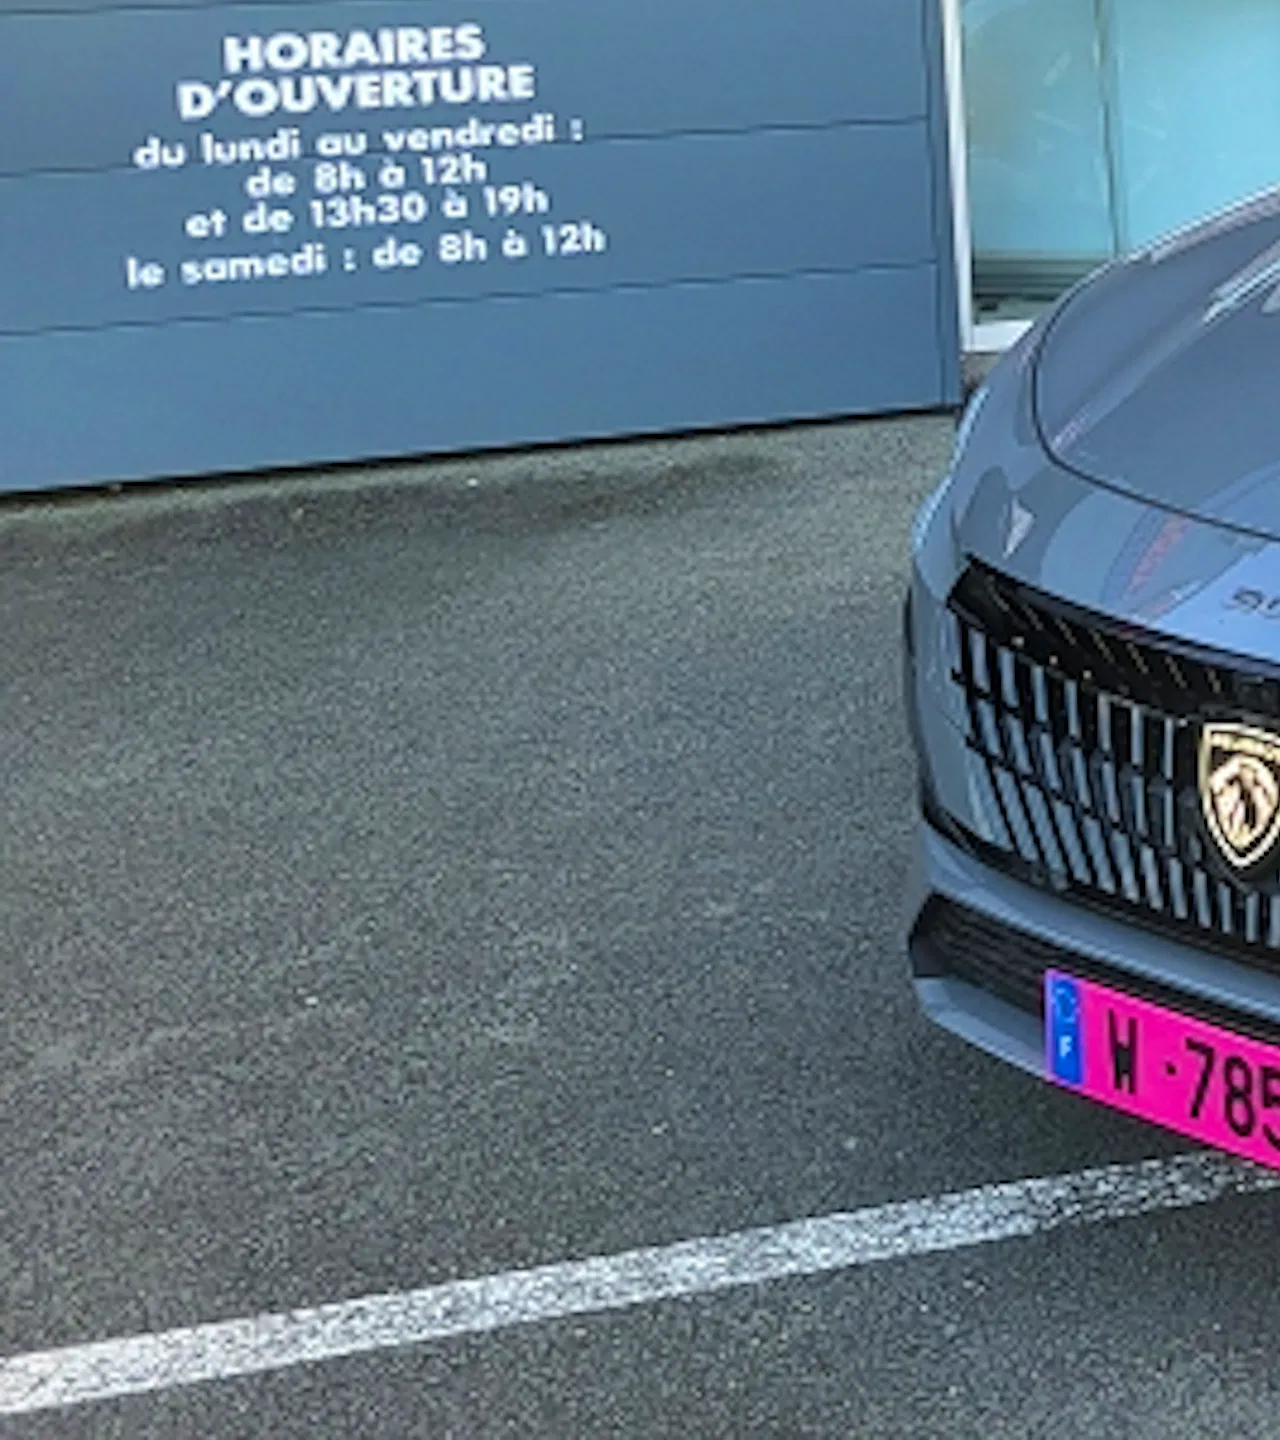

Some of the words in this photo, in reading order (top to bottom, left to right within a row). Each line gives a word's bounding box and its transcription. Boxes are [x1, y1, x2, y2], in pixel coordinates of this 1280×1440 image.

[222, 23, 487, 73] HORAIRES
[176, 63, 535, 121] D’OUVERTURE
[133, 135, 185, 170] du
[202, 129, 301, 166] lundi
[316, 130, 368, 157] au
[381, 113, 558, 153] vendredi
[246, 166, 296, 199] de
[314, 161, 366, 193] 8h
[378, 158, 406, 189] à
[421, 155, 488, 187] 12h
[184, 209, 228, 241] et
[242, 203, 295, 234] de
[310, 194, 428, 231] 13h30
[442, 188, 469, 219] à
[484, 183, 550, 216] 19h
[126, 258, 166, 291] le
[180, 244, 328, 285] samedi
[372, 237, 424, 270] de
[438, 231, 488, 263] 8h
[502, 227, 531, 258] à
[541, 223, 607, 257] 12h
